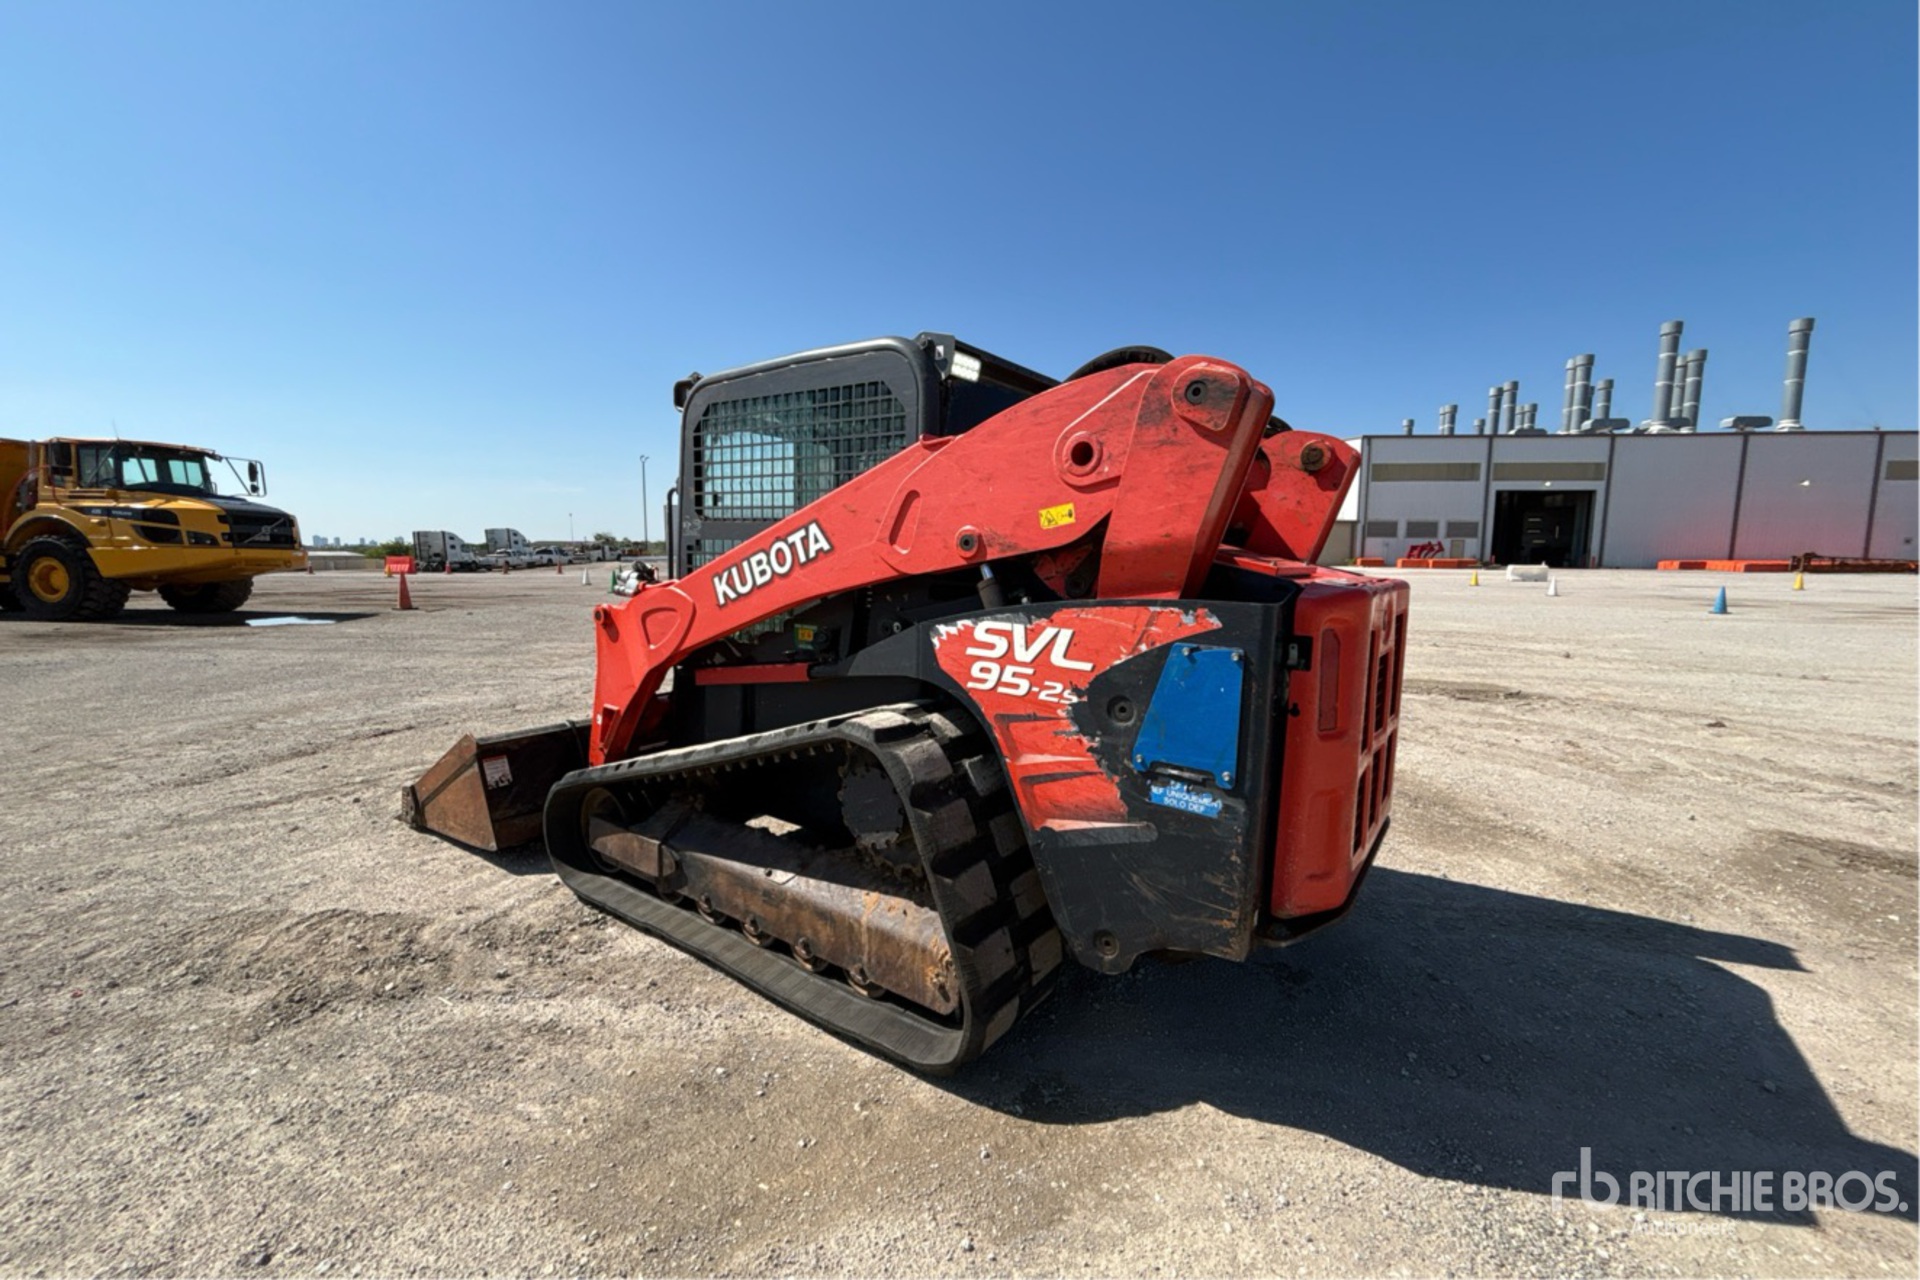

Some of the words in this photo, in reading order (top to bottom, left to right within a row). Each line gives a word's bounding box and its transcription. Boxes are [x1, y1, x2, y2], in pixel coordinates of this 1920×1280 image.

[713, 521, 832, 606] KUBOTA
[965, 620, 1094, 672] SVL
[1163, 796, 1187, 809] SOLO
[1188, 802, 1206, 814] DEF
